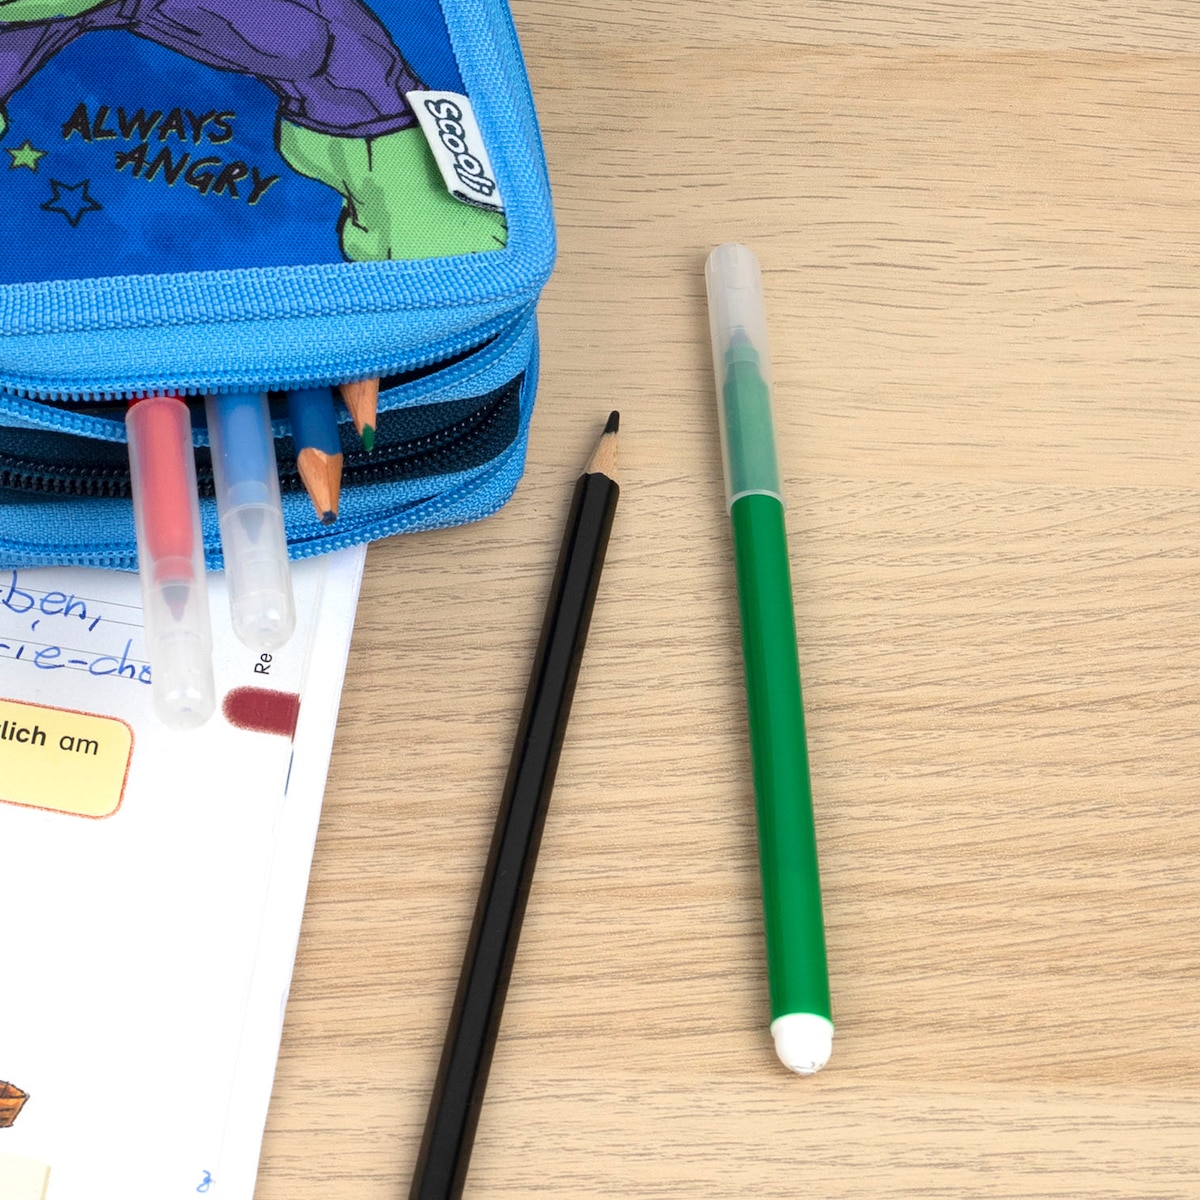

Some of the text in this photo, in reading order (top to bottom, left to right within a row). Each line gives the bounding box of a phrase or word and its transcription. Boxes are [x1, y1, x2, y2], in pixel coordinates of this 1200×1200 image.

[61, 102, 236, 145] ALWAYS
[115, 142, 280, 206] ANGRY
[59, 736, 99, 756] am
